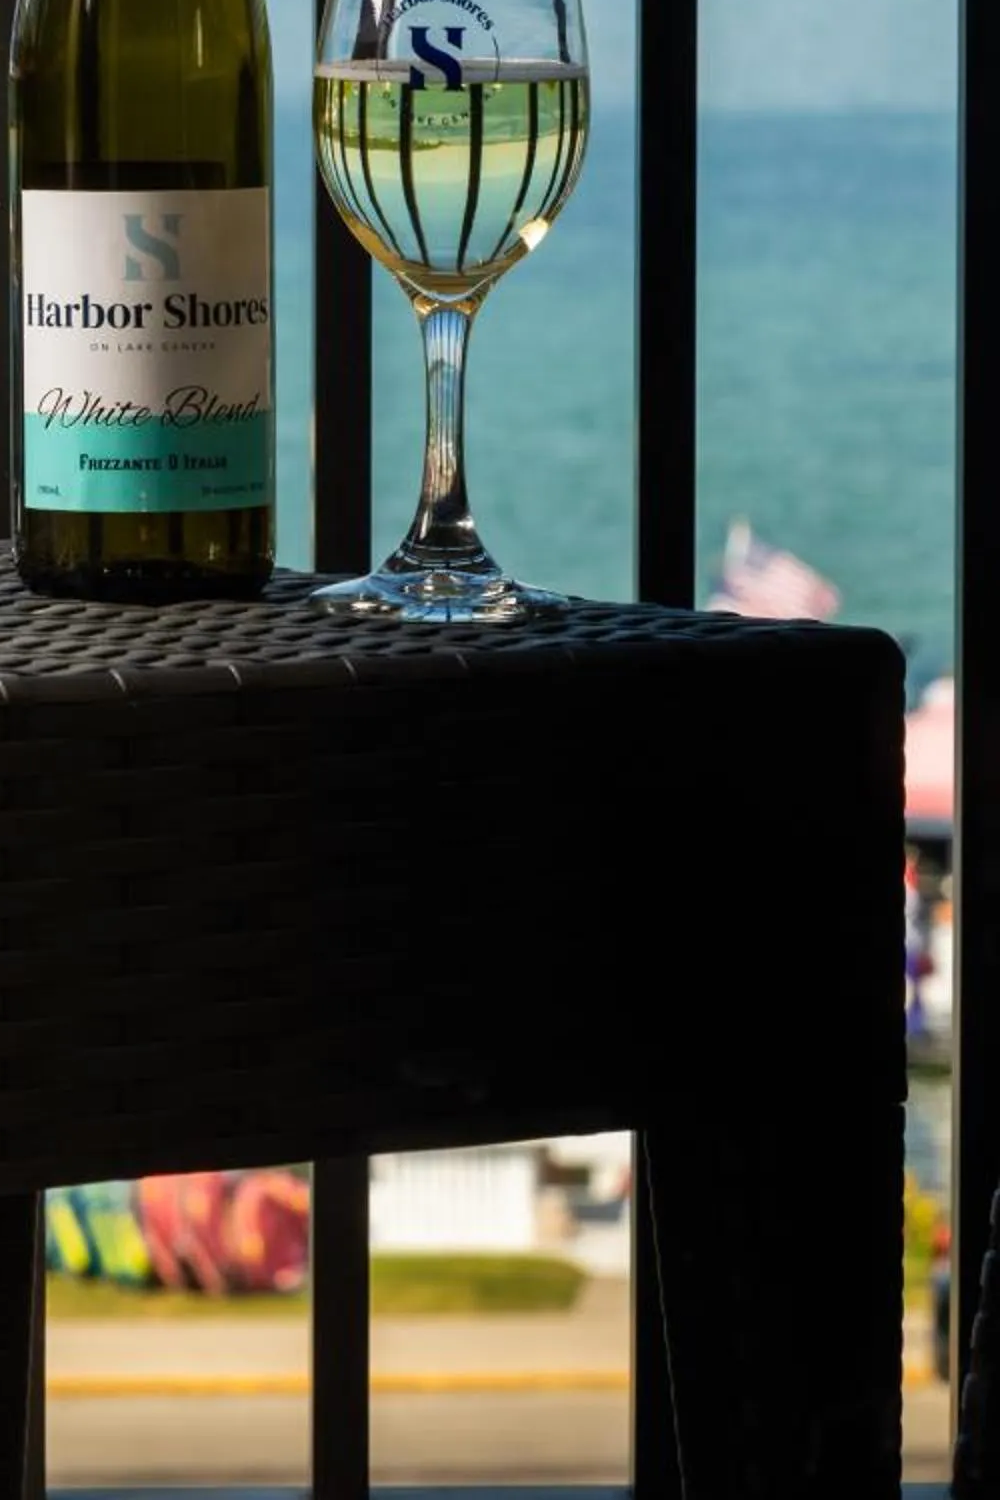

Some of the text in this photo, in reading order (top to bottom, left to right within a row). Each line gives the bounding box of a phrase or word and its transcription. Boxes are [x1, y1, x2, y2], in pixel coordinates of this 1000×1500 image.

[26, 292, 268, 329] Harbor Shores
[37, 384, 261, 430] White Blend
